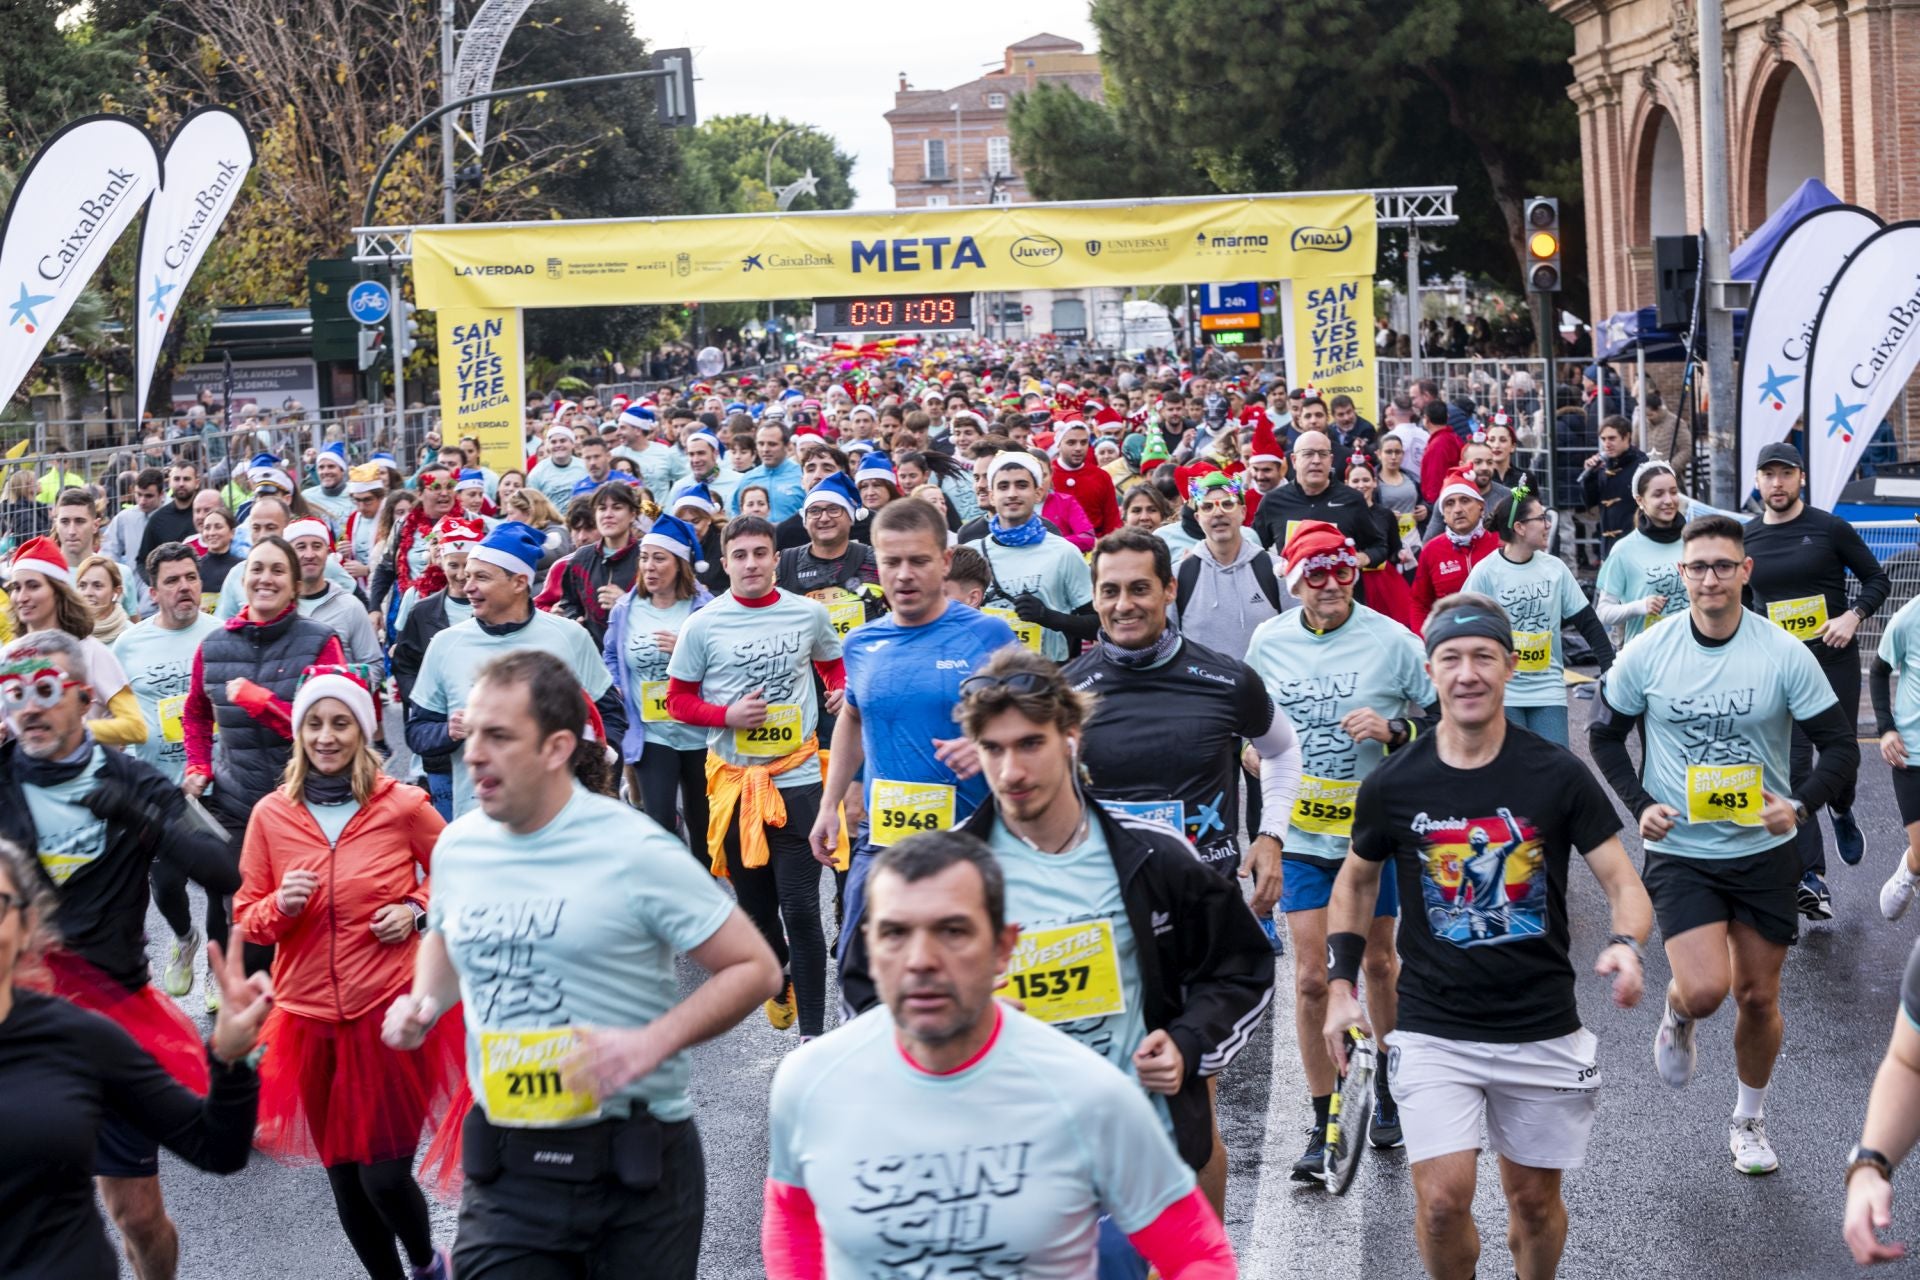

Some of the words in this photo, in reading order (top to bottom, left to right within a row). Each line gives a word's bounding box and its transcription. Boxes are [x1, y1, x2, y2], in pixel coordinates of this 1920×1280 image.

[38, 167, 135, 281] CaixaBank
[164, 159, 240, 270] CaixaBank
[1015, 245, 1057, 259] Juver
[1211, 235, 1269, 248] marmo
[1299, 232, 1344, 246] VIDAL
[768, 253, 835, 267] CaixaBank
[851, 236, 986, 273] META
[453, 265, 473, 277] LA
[475, 263, 535, 276] VERDAD
[1224, 296, 1247, 308] 24h
[1306, 281, 1359, 310] SAN
[1315, 303, 1352, 328] SIL
[452, 317, 503, 345] SAN
[1216, 332, 1245, 344] LIBRE
[1311, 319, 1358, 347] VES
[1850, 273, 1920, 390] CaixaBan
[460, 338, 496, 363] SIL
[1312, 340, 1360, 367] TRE
[457, 355, 503, 382] VES
[1312, 358, 1365, 381] MURCIA
[457, 376, 505, 402] TRE
[1326, 385, 1364, 394] VERDAD
[458, 394, 510, 415] MURCIA
[470, 420, 510, 429] VERDAD
[1501, 580, 1551, 608] SAN
[1511, 599, 1546, 625] SIL
[1781, 616, 1817, 631] 1799
[733, 631, 801, 668] SAN
[746, 656, 793, 687] SIL
[935, 659, 969, 670] BBVA
[1199, 669, 1236, 686] CaixaBank
[1279, 672, 1359, 706] SAN
[1289, 700, 1342, 733] SIL
[1668, 688, 1755, 724] SAN
[746, 727, 793, 742] 2280
[1682, 718, 1742, 749] SIL
[1694, 770, 1722, 783] SAN
[1694, 768, 1758, 794] SILVESTRE
[1298, 800, 1353, 820] 3529
[1707, 791, 1749, 810] 483
[882, 809, 939, 830] 3948
[453, 898, 566, 946] SAN
[1010, 936, 1038, 957] AN
[467, 943, 547, 986] SIL
[1012, 964, 1091, 1000] 1537
[505, 1071, 564, 1097] 2111
[850, 1141, 1035, 1214] SAN
[875, 1203, 1008, 1268] SIL
